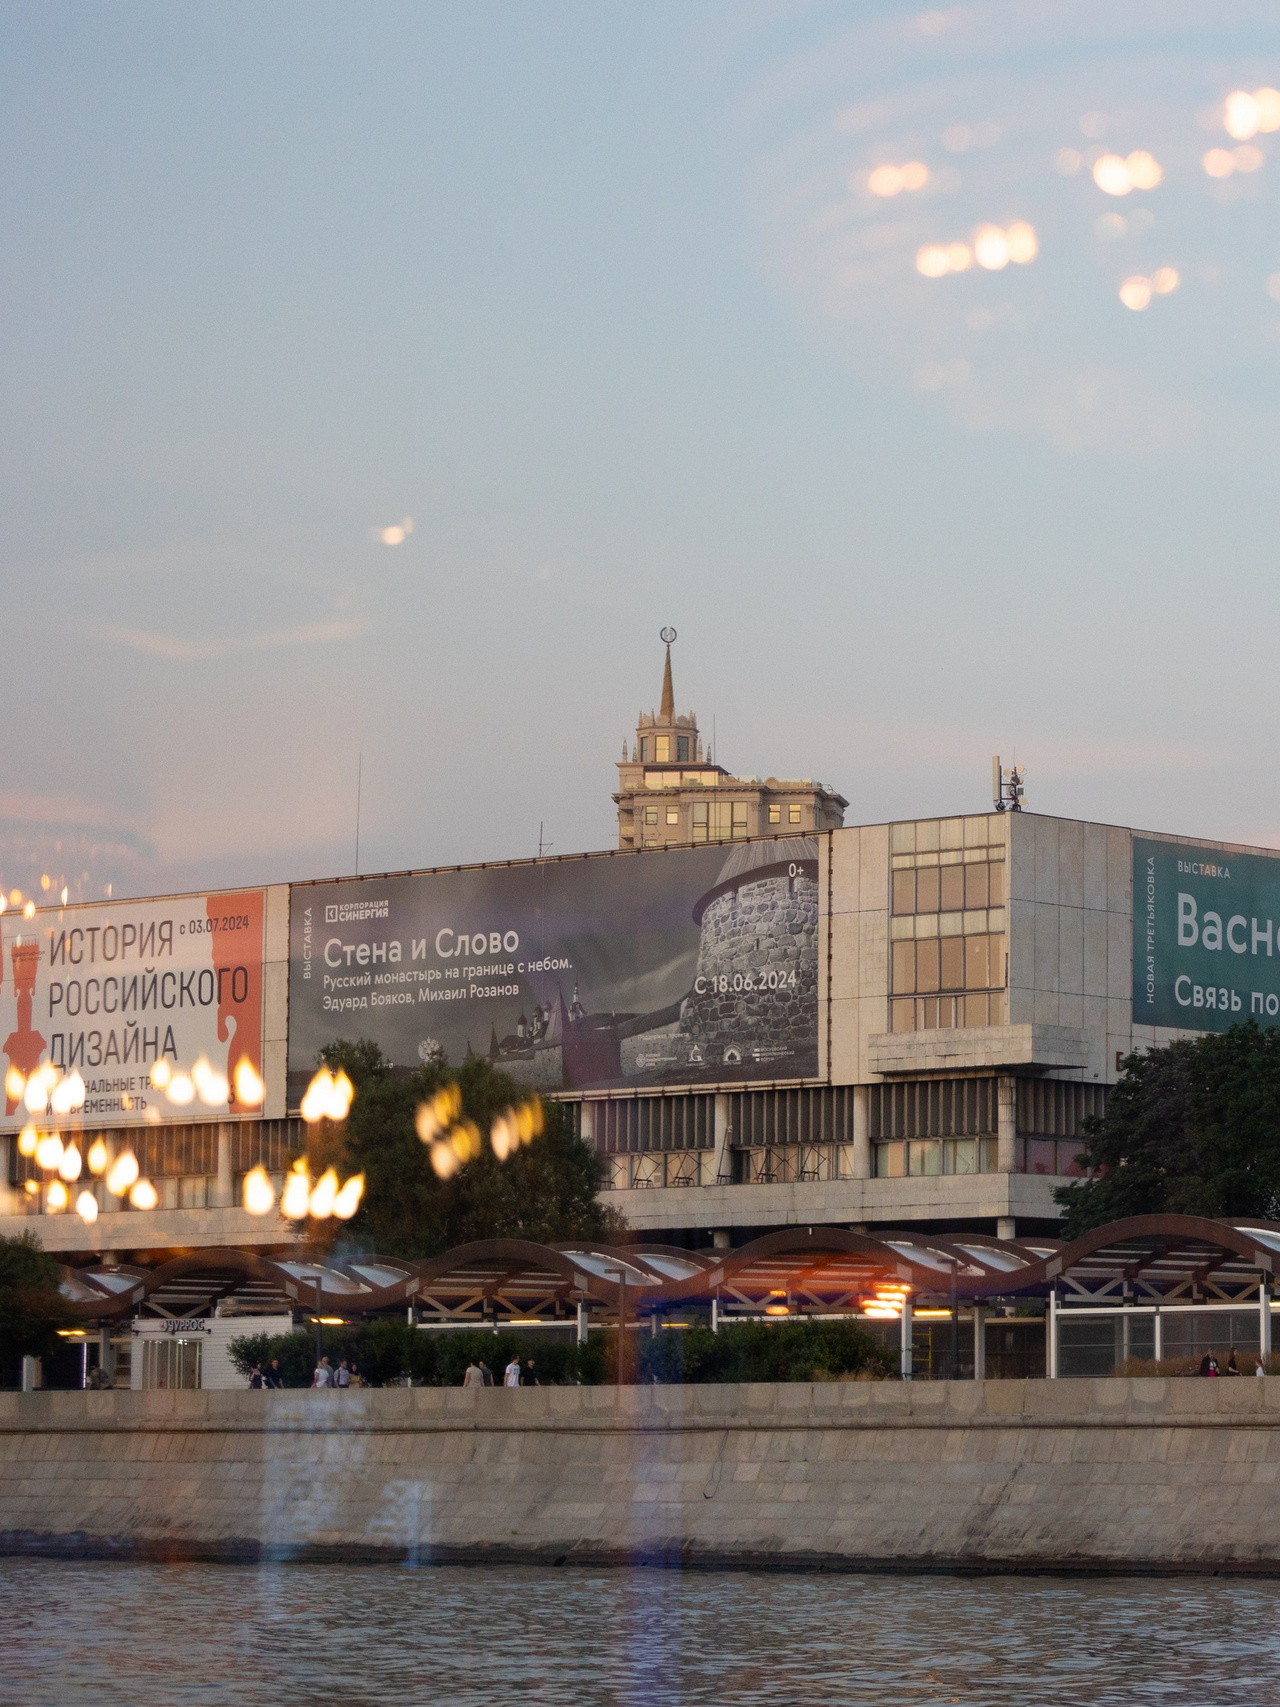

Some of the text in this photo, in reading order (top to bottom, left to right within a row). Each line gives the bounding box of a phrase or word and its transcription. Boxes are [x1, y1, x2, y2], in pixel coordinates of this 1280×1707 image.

[788, 862, 804, 878] 0+
[1177, 860, 1231, 879] ВЫСТАВКА
[338, 907, 389, 922] СИНЕРГИЯ
[339, 900, 389, 911] КОРПОРАЦИЯ
[50, 919, 173, 967] ИСТОРИЯ
[179, 923, 187, 935] с
[189, 914, 250, 935] 03.07.2024
[303, 907, 312, 979] ВЫСТАВКА
[324, 927, 520, 968] Стена и Слово
[1146, 856, 1155, 1004] НОВАЯ ТРЕТЬЯКОВКА
[323, 956, 573, 991] Русский монастырь на границе с небом.
[694, 969, 797, 994] С 18.06.2024
[49, 965, 249, 1018] РОССИЙСКОГО
[322, 983, 519, 1013] Эдуард Бояков, Михаил Розанов
[1174, 974, 1242, 1012] Связь
[50, 1019, 178, 1074] ДИЗАЙНА
[167, 1319, 205, 1332] ЧУРРОС
